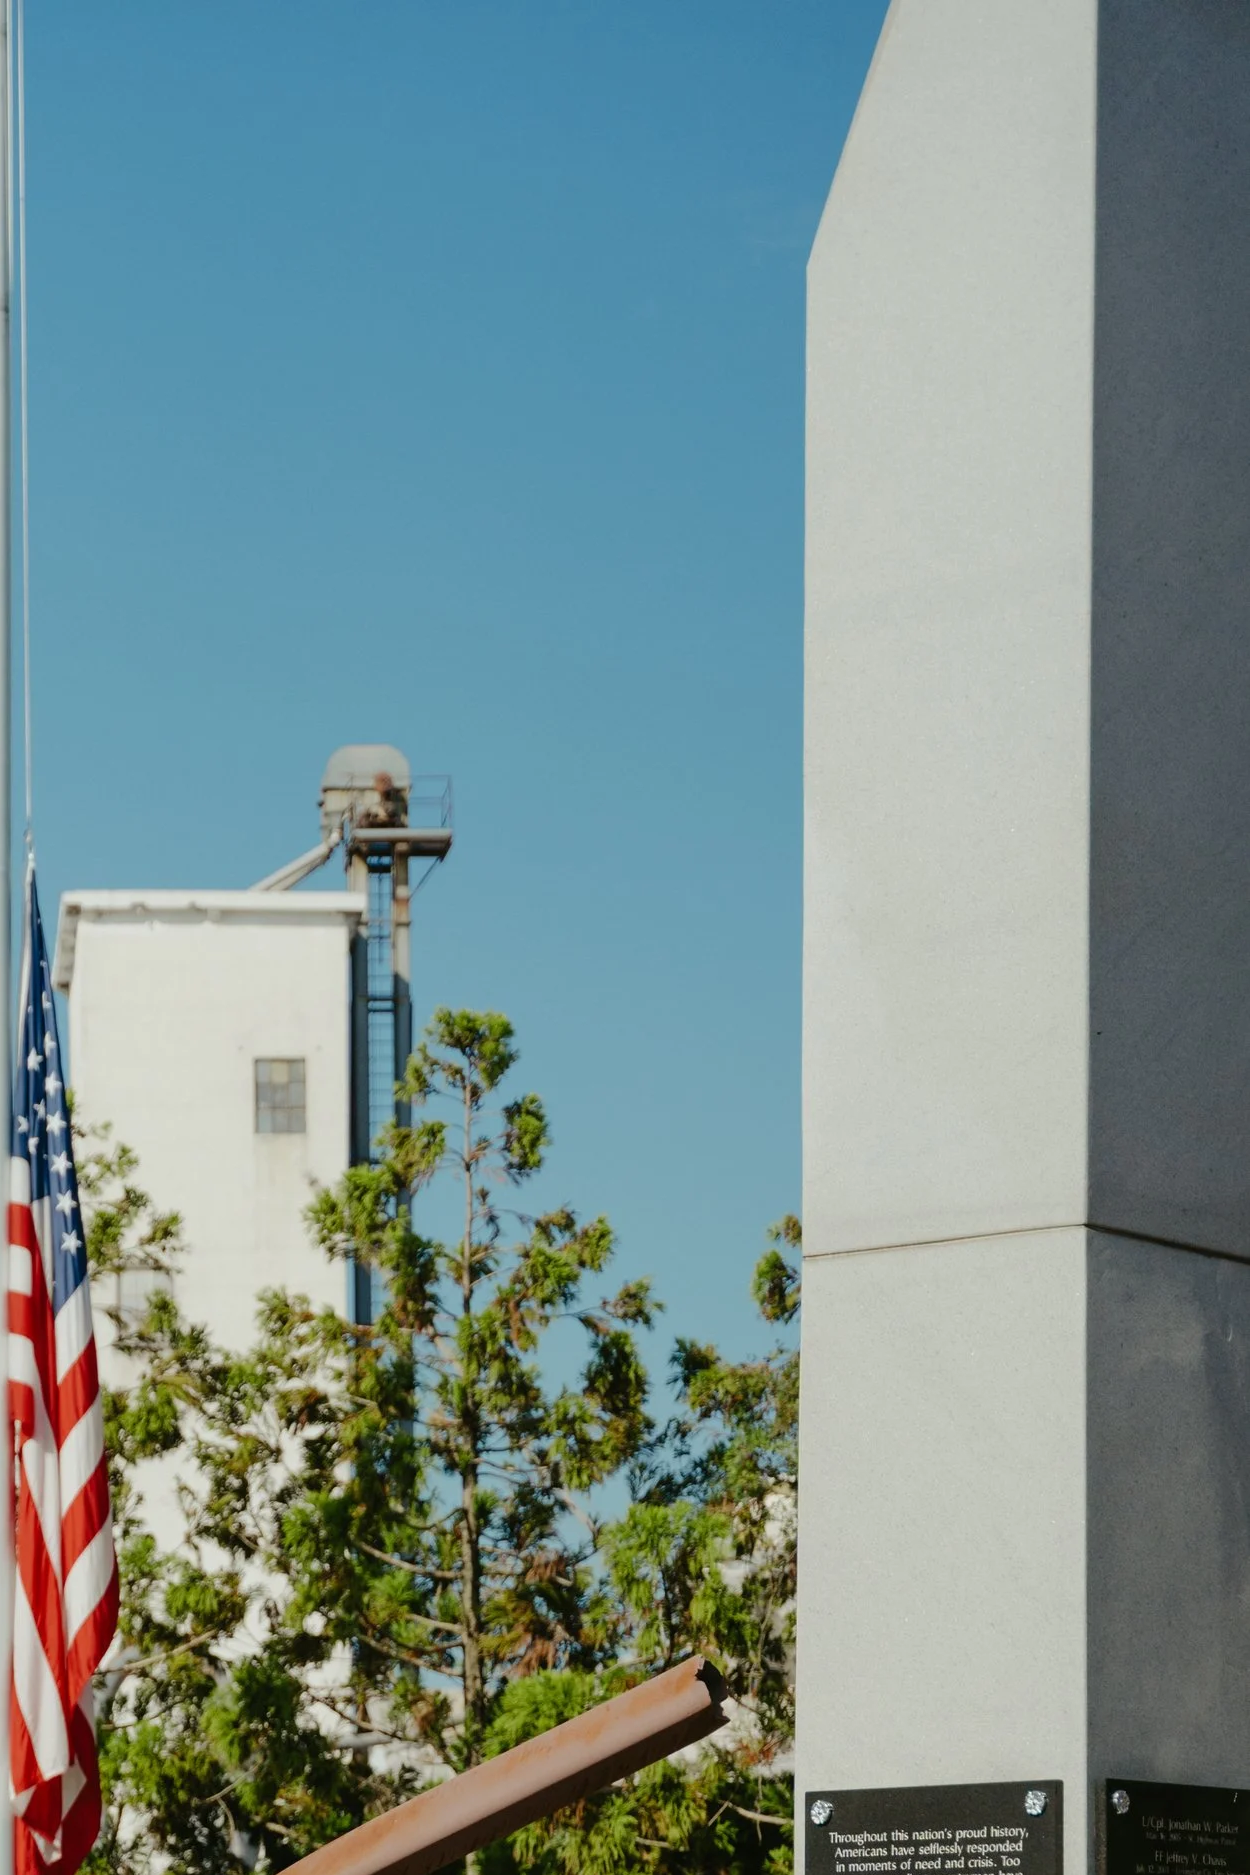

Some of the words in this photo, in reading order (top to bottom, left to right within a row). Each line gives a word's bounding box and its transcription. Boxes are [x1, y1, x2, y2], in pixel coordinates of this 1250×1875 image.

[828, 1829, 887, 1845] Throughout
[891, 1829, 908, 1840] this
[912, 1828, 952, 1840] nation's
[955, 1827, 987, 1842] proud
[990, 1826, 1028, 1842] history,
[834, 1844, 887, 1856] Americans
[890, 1843, 915, 1855] have
[918, 1842, 963, 1858] selflessly
[966, 1841, 1022, 1857] responded
[835, 1859, 845, 1871] in
[848, 1858, 897, 1870] moments
[899, 1858, 911, 1870] of
[914, 1858, 941, 1869] need
[944, 1857, 964, 1869] and
[967, 1857, 997, 1868] crisis.
[1001, 1856, 1020, 1868] Too
